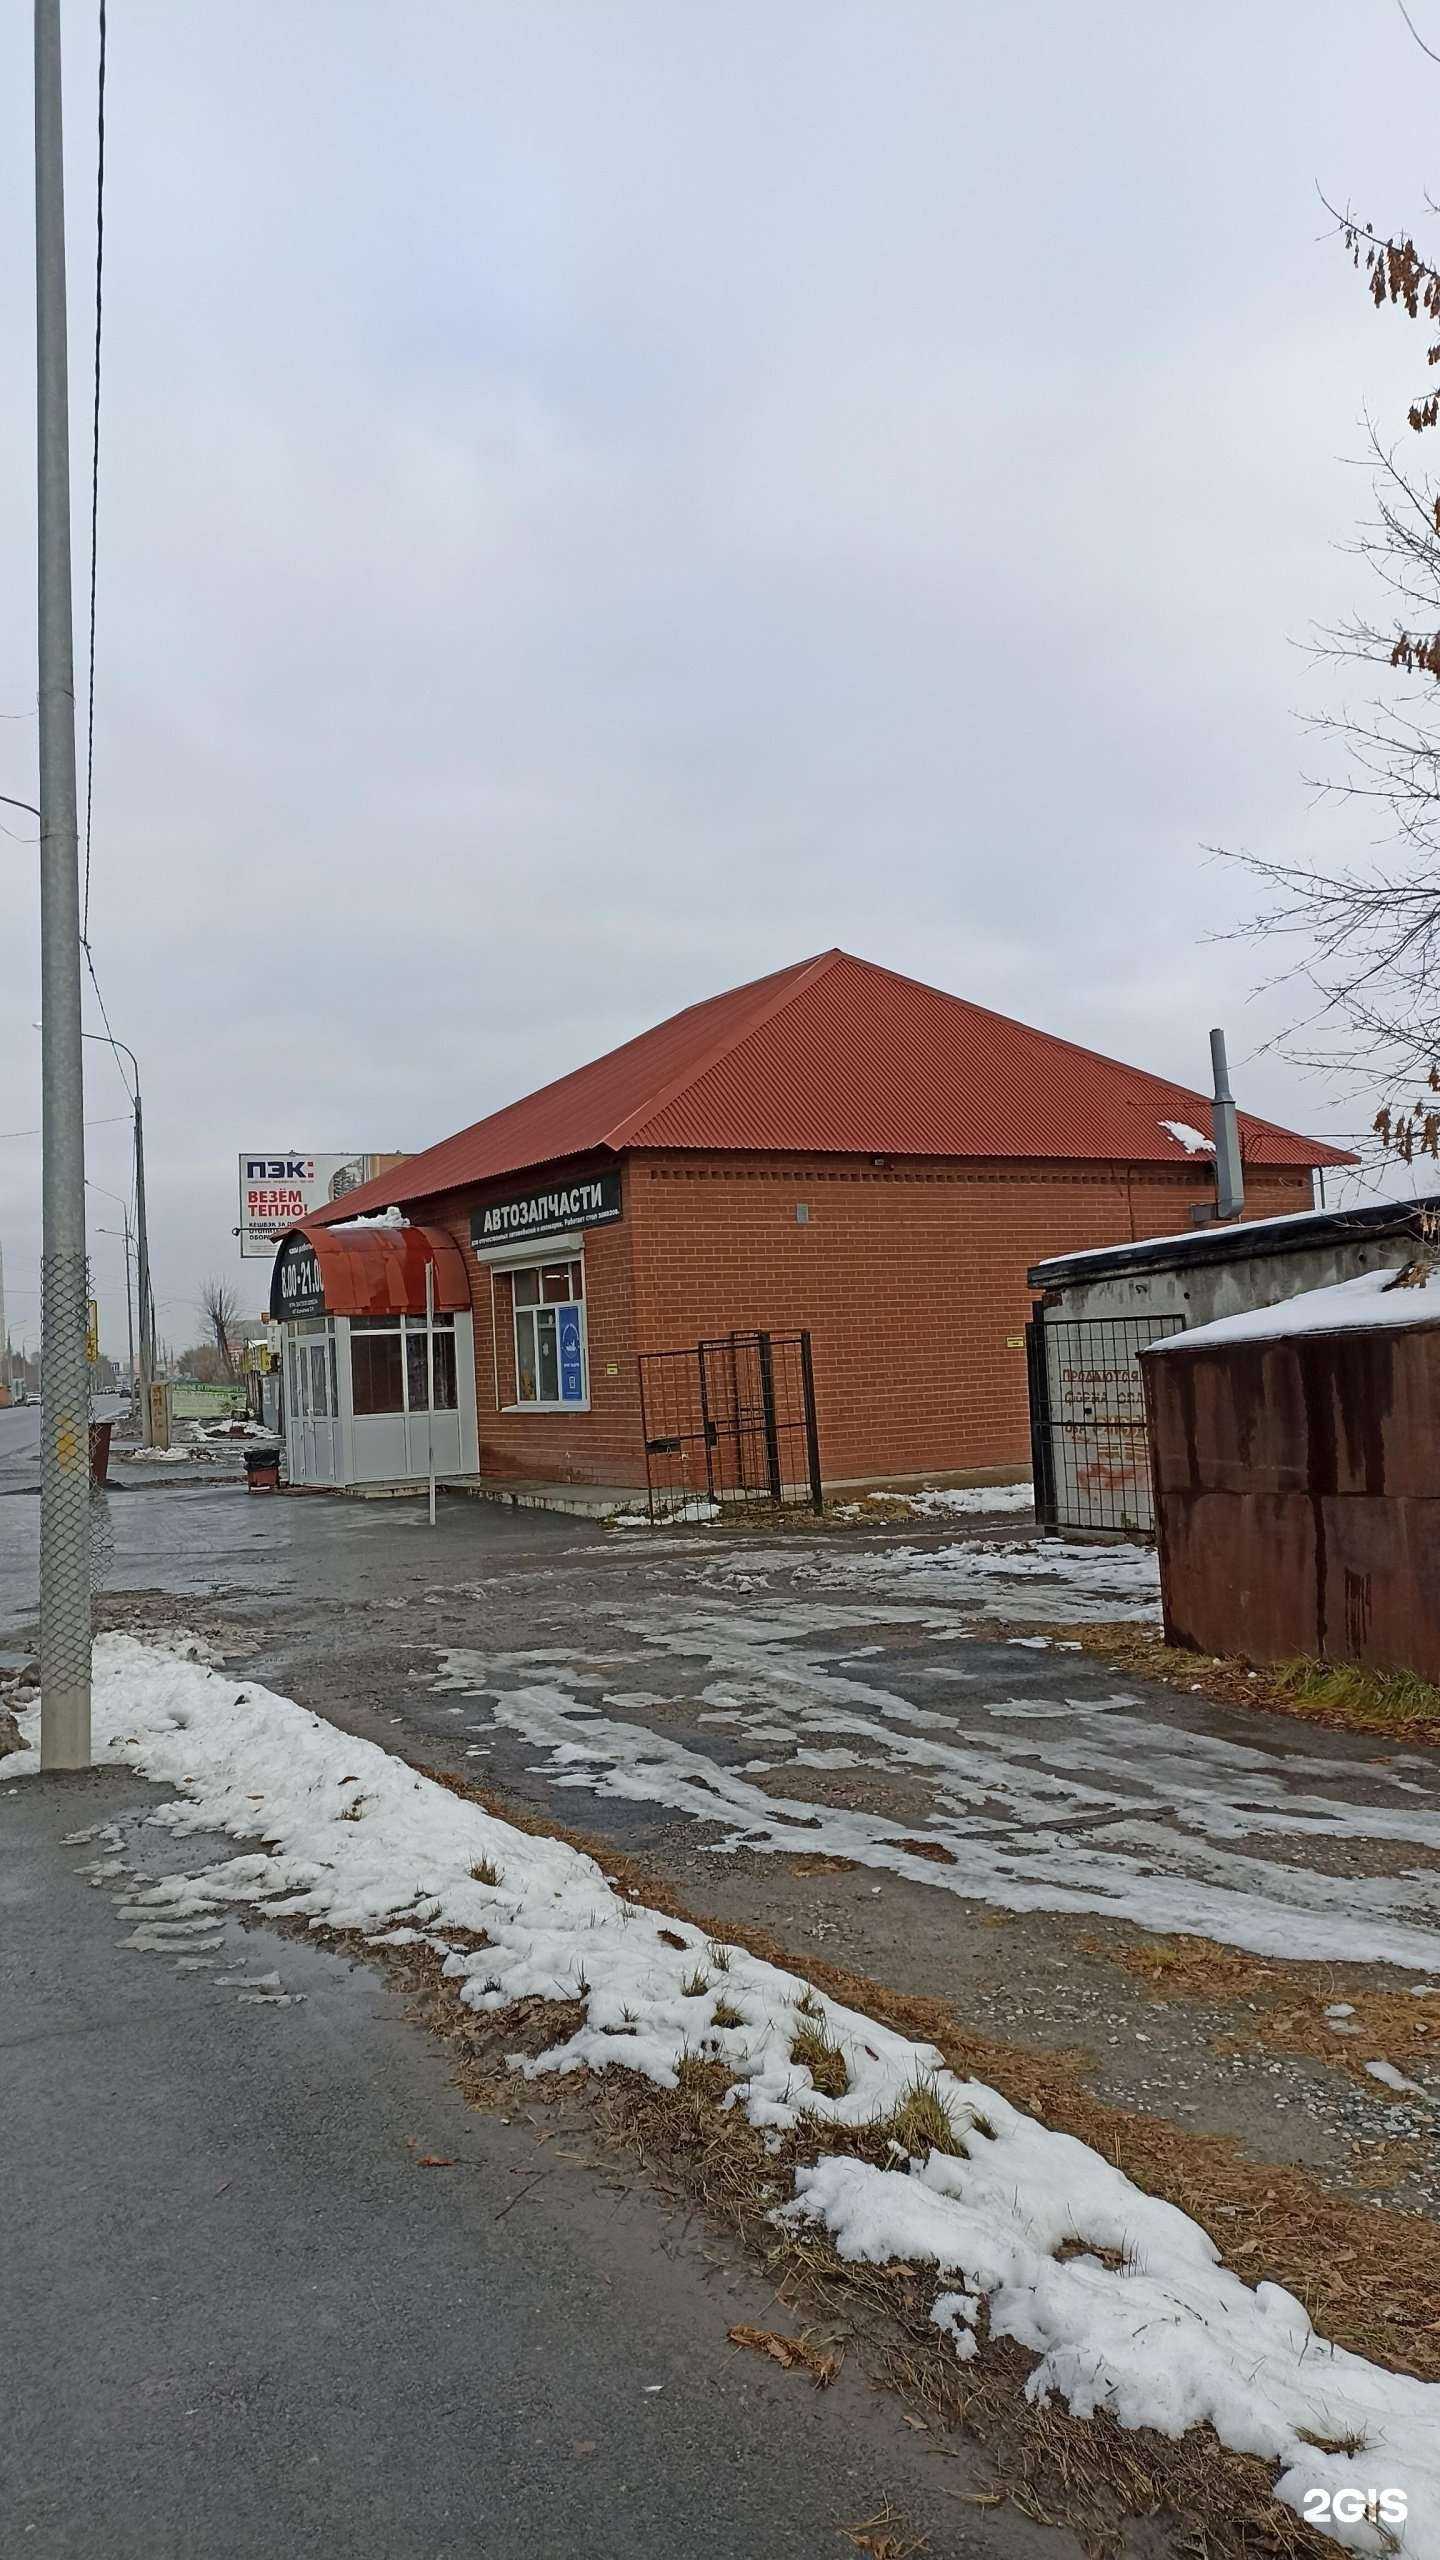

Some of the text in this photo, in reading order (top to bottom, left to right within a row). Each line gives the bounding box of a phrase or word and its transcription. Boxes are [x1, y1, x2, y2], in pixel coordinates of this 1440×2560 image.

[248, 1188, 302, 1203] ВЕЗЁМ
[248, 1204, 308, 1216] ТЕПЛО!
[484, 1183, 602, 1232] АВТОЗАПЧАСТИ
